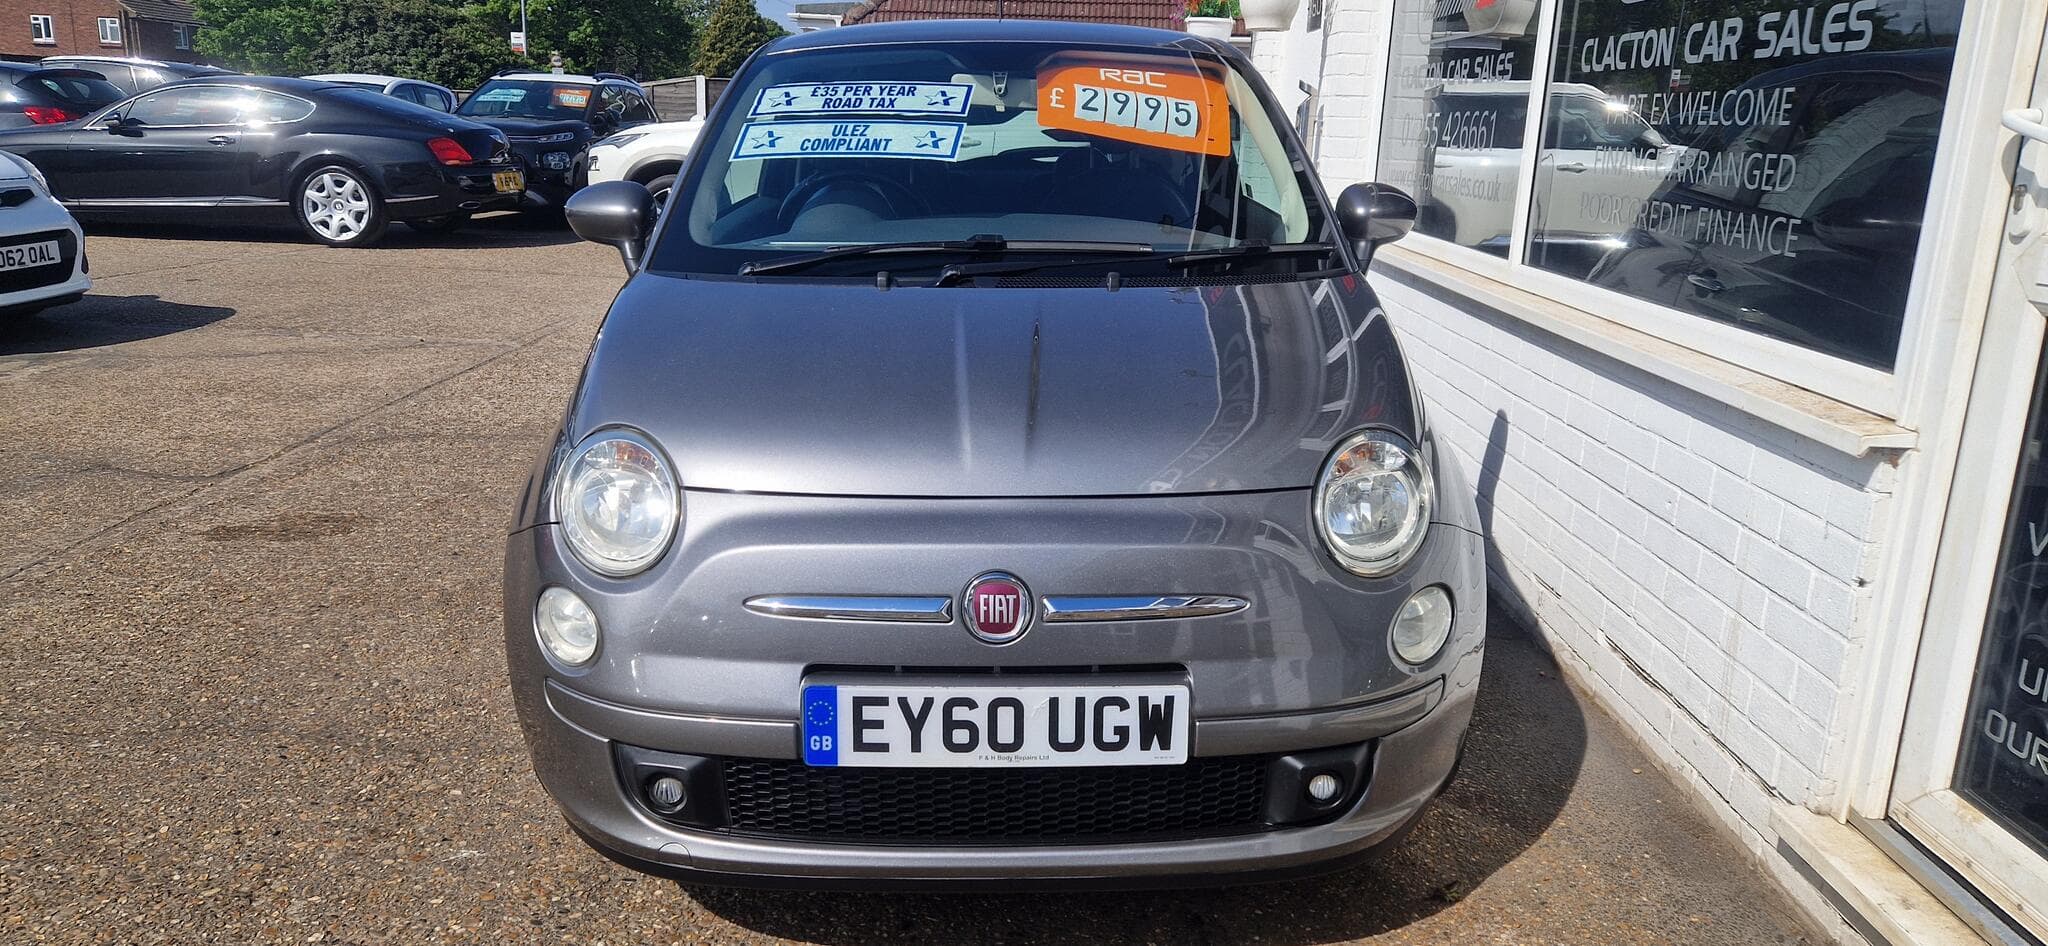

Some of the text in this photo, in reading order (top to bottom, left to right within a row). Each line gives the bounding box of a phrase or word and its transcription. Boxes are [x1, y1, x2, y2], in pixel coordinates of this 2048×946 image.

[1580, 0, 1877, 73] CLACTON CAR SALES
[1447, 59, 1470, 85] CAR
[1474, 52, 1515, 82] SALES
[810, 85, 917, 97] £35 PER YEAR
[821, 97, 898, 109] ROAD TAX
[1049, 87, 1192, 127] £ 2995
[1606, 87, 1797, 126] PART EX WELCOME
[800, 138, 893, 151] COMPLIANT
[831, 124, 871, 137] ULEZ
[1442, 110, 1498, 151] 426661
[1594, 146, 1798, 192] FINANCE ARRANGED
[1579, 193, 1802, 258] POOR CREDIT FINANCE
[979, 594, 1018, 624] FIAT
[852, 695, 1175, 753] EY60 UGW
[809, 735, 833, 751] GB
[997, 754, 1013, 762] Body
